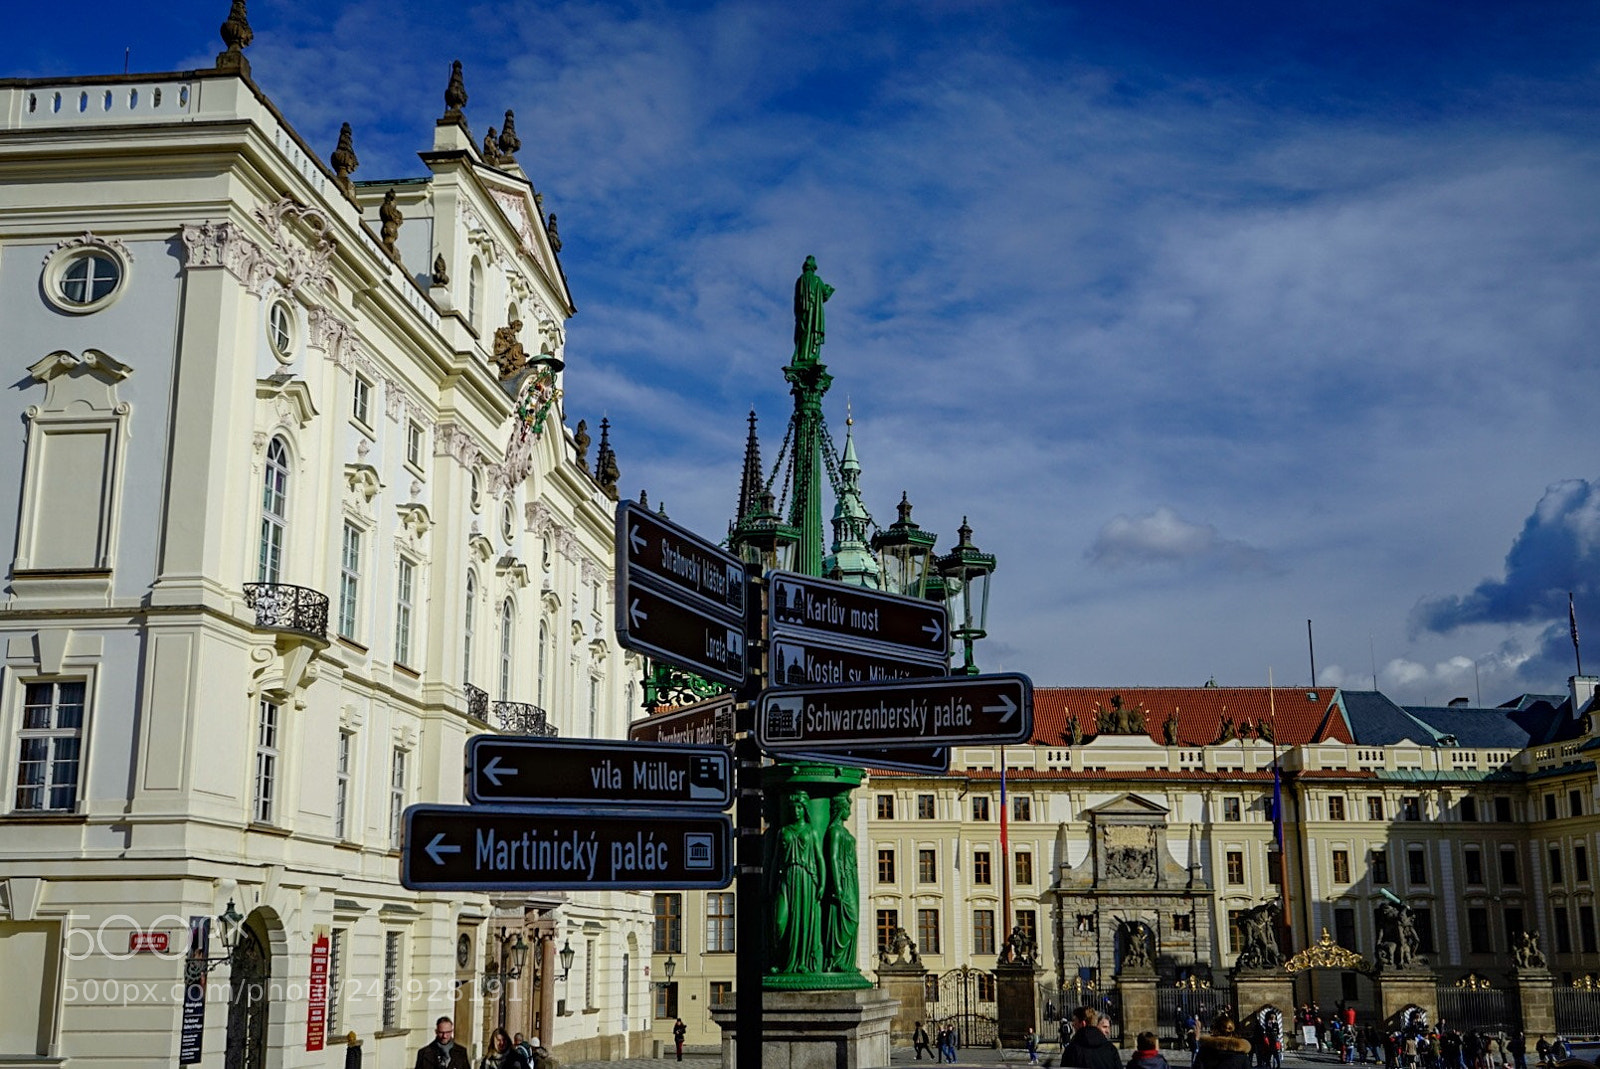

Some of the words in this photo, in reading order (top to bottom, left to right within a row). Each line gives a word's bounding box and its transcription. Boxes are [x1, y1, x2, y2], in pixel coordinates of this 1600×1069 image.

[661, 538, 701, 591] Strahovský
[702, 558, 725, 596] klášter
[806, 593, 846, 625] Karlův
[850, 608, 879, 632] most
[705, 627, 726, 663] Loreta
[806, 655, 843, 684] Kostel
[696, 717, 714, 745] palác
[806, 698, 928, 736] Schwarzenberský
[934, 697, 973, 735] palác
[590, 759, 623, 790] vila
[633, 760, 686, 792] Müller
[475, 828, 599, 881] Martinický
[610, 832, 669, 881] palác
